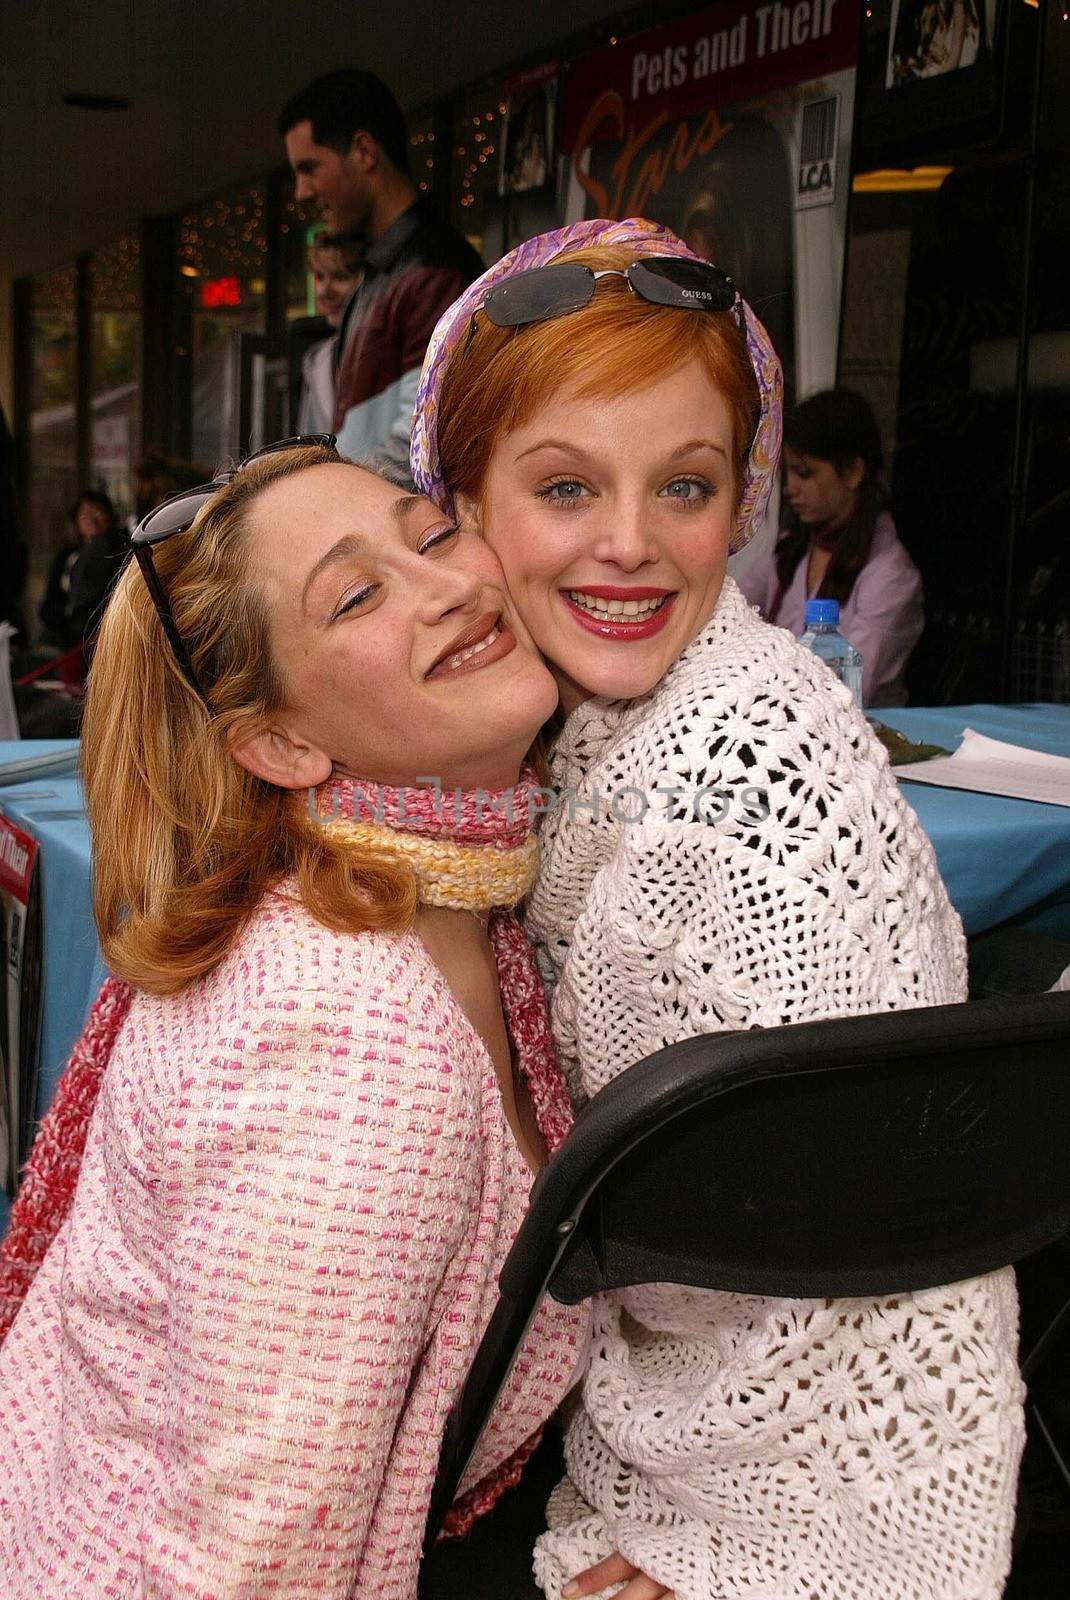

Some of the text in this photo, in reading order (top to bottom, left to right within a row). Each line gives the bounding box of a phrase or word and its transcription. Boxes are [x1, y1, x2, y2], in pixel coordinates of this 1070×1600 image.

[631, 0, 836, 100] Pets and Their
[681, 289, 713, 301] GUESS
